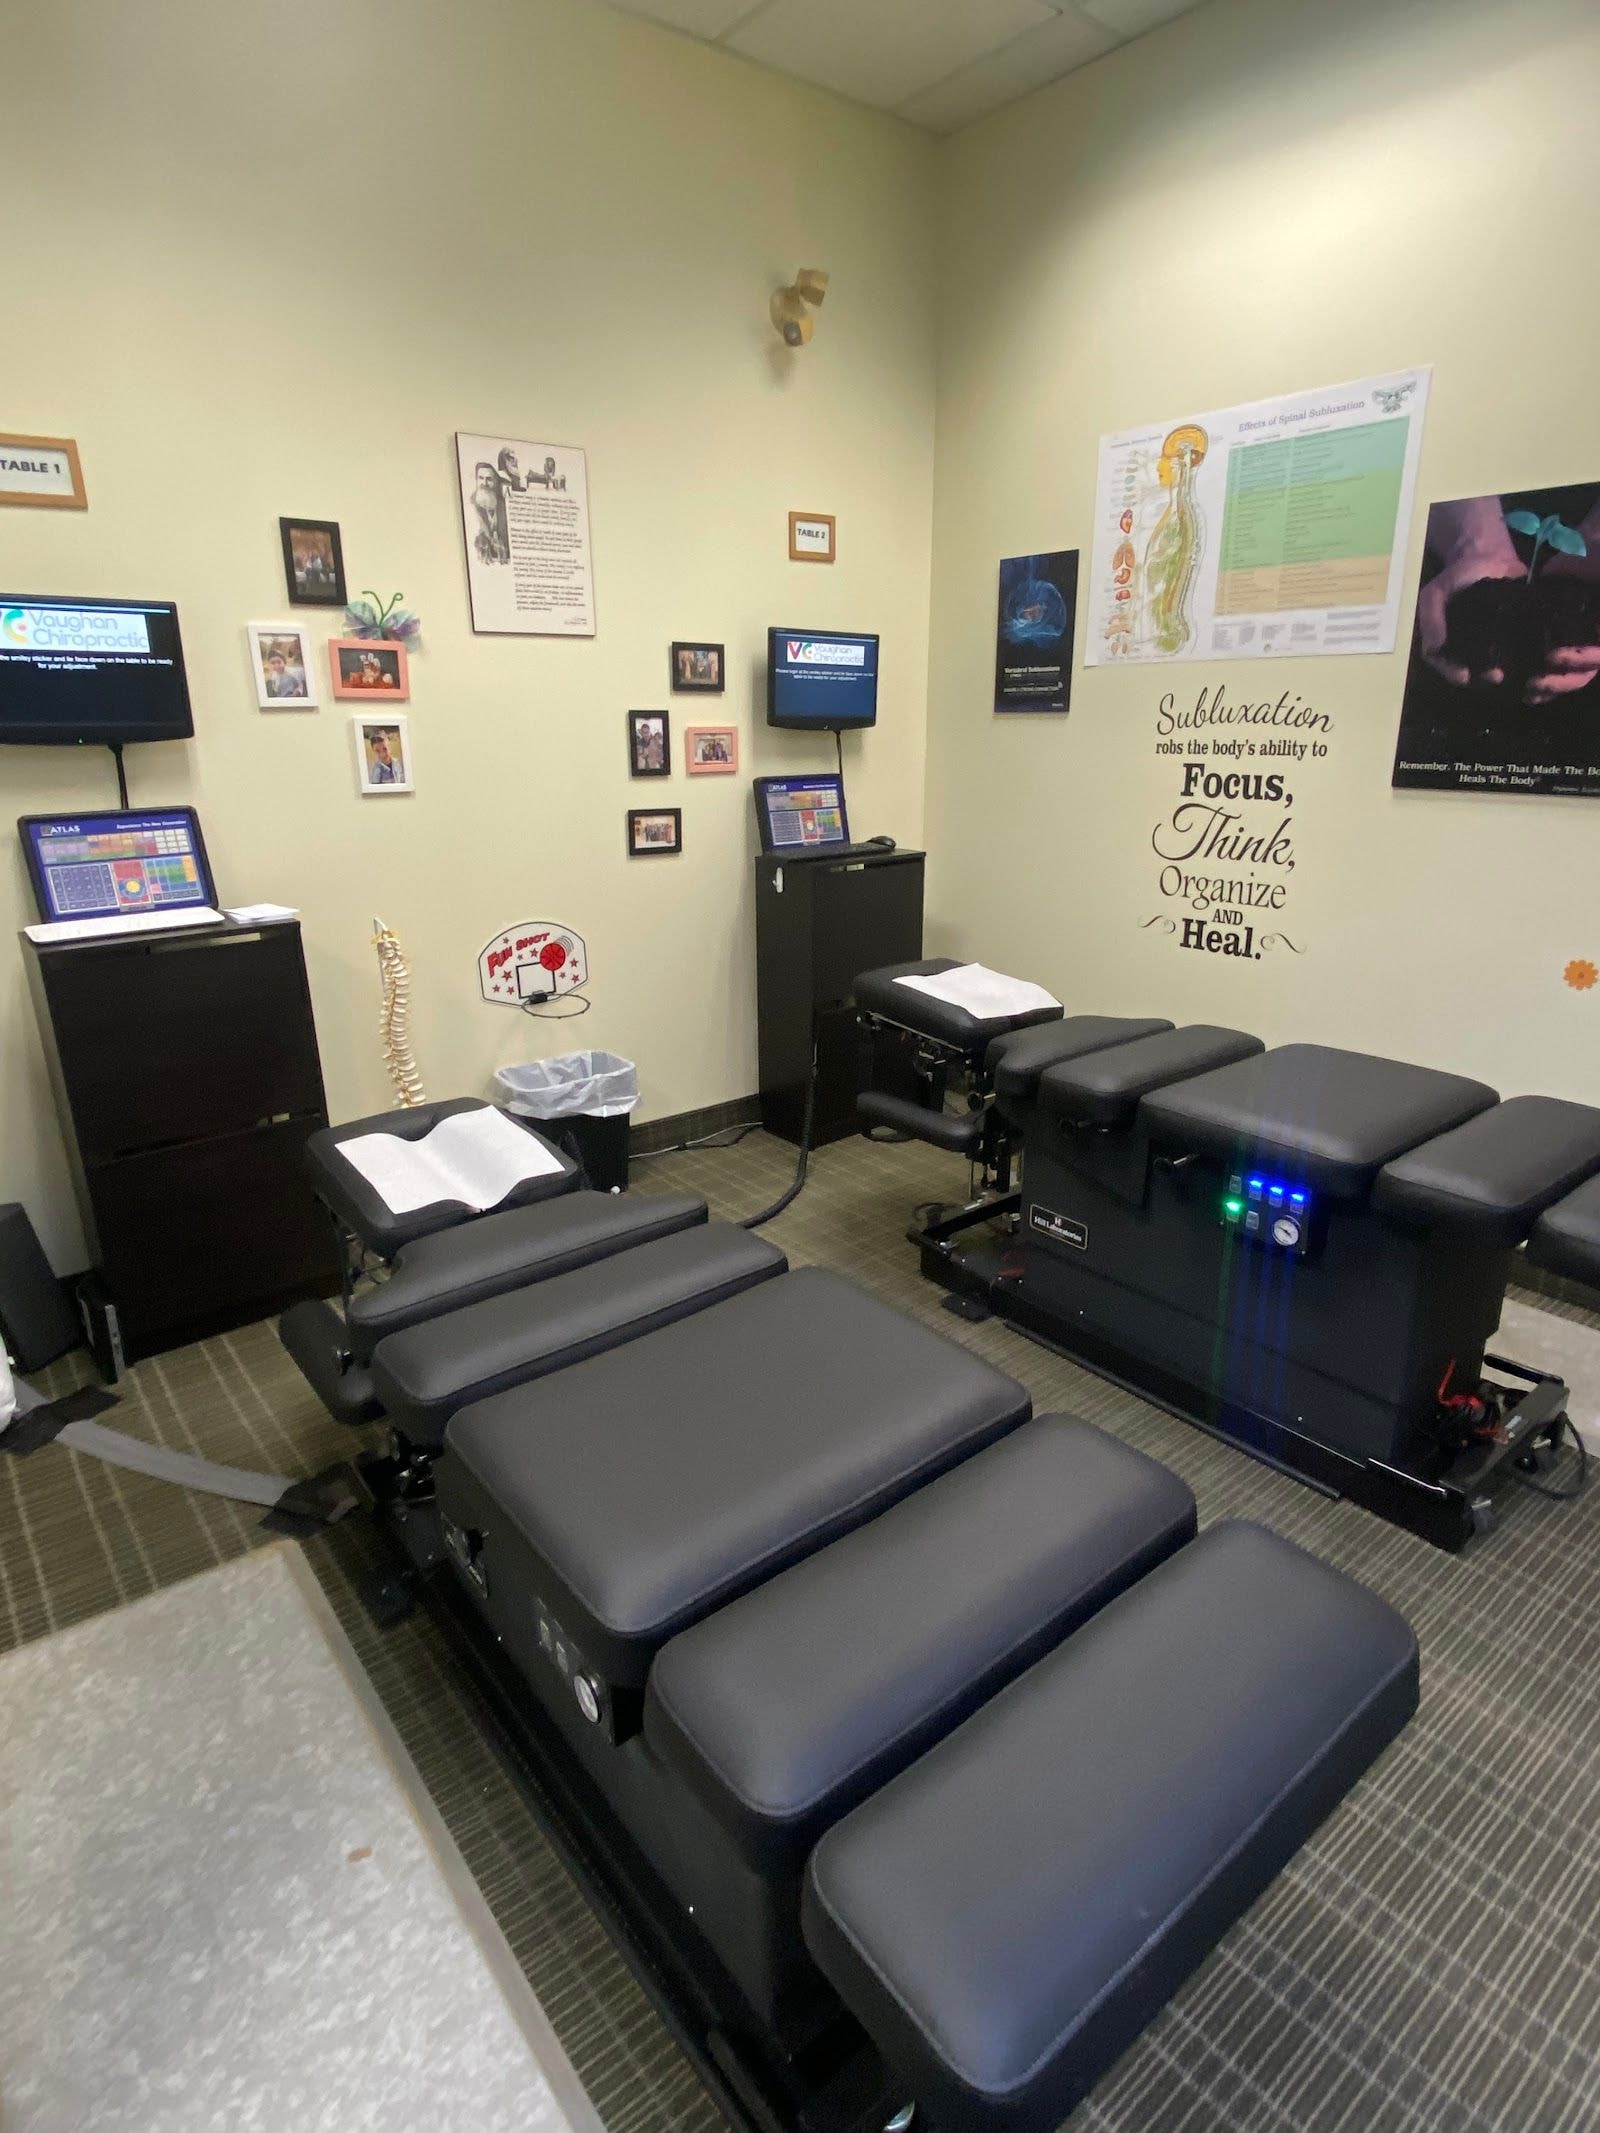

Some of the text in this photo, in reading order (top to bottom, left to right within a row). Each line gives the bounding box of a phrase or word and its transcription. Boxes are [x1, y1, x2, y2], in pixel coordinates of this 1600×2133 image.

[1239, 400, 1365, 432] Effects of Spinal Subluxation
[0, 459, 61, 474] TABLE 1
[797, 528, 826, 539] TABLE 2
[28, 609, 118, 633] Vaughan
[32, 628, 149, 654] Chiropractic
[814, 643, 853, 655] Vaughan
[1157, 684, 1335, 736] Subluxation
[1155, 739, 1328, 761] robs the body's ability to
[1454, 762, 1472, 772] The
[1474, 763, 1504, 773] Power
[1506, 763, 1530, 774] That
[1532, 764, 1561, 774] Made
[1564, 765, 1585, 775] The
[1459, 774, 1487, 784] Heals
[1489, 775, 1508, 784] The
[1180, 762, 1294, 809] Focus,
[51, 825, 81, 834] ATLAS
[1152, 802, 1296, 874] Think,
[1159, 864, 1287, 911] Organize
[1212, 908, 1243, 926] AND
[1179, 917, 1262, 960] Heal.
[1034, 1215, 1046, 1227] Hill
